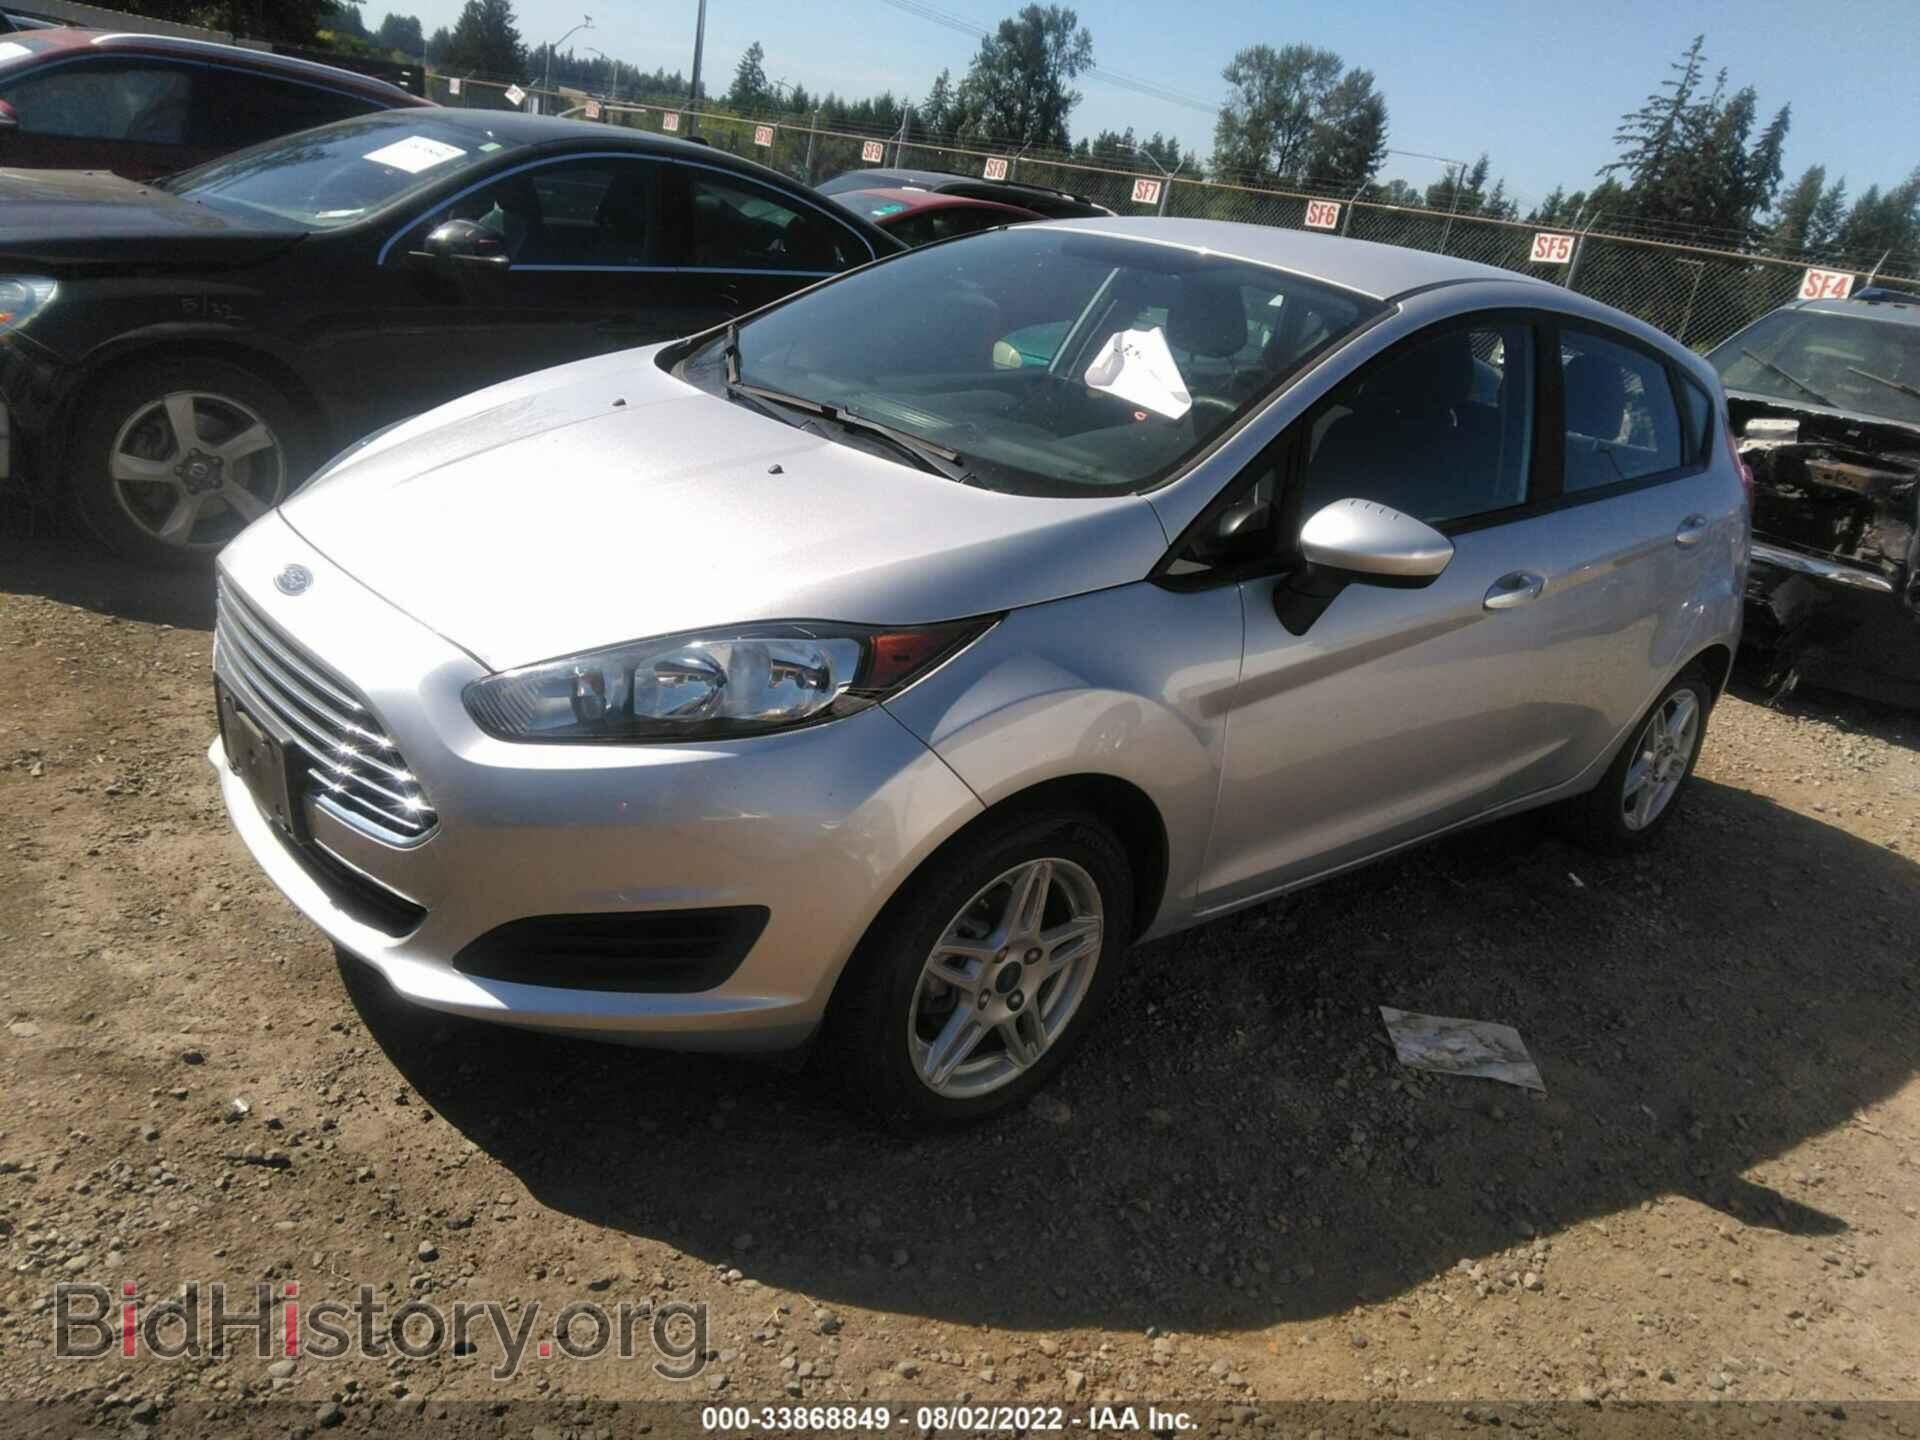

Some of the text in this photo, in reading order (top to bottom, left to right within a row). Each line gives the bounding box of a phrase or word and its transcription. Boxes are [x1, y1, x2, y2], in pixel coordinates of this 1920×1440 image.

[864, 143, 881, 160] SF9
[986, 159, 1005, 178] SF8
[1135, 180, 1158, 201] SF7
[1308, 203, 1336, 225] SF6
[1535, 236, 1569, 259] SF5
[1804, 272, 1848, 298] SF4
